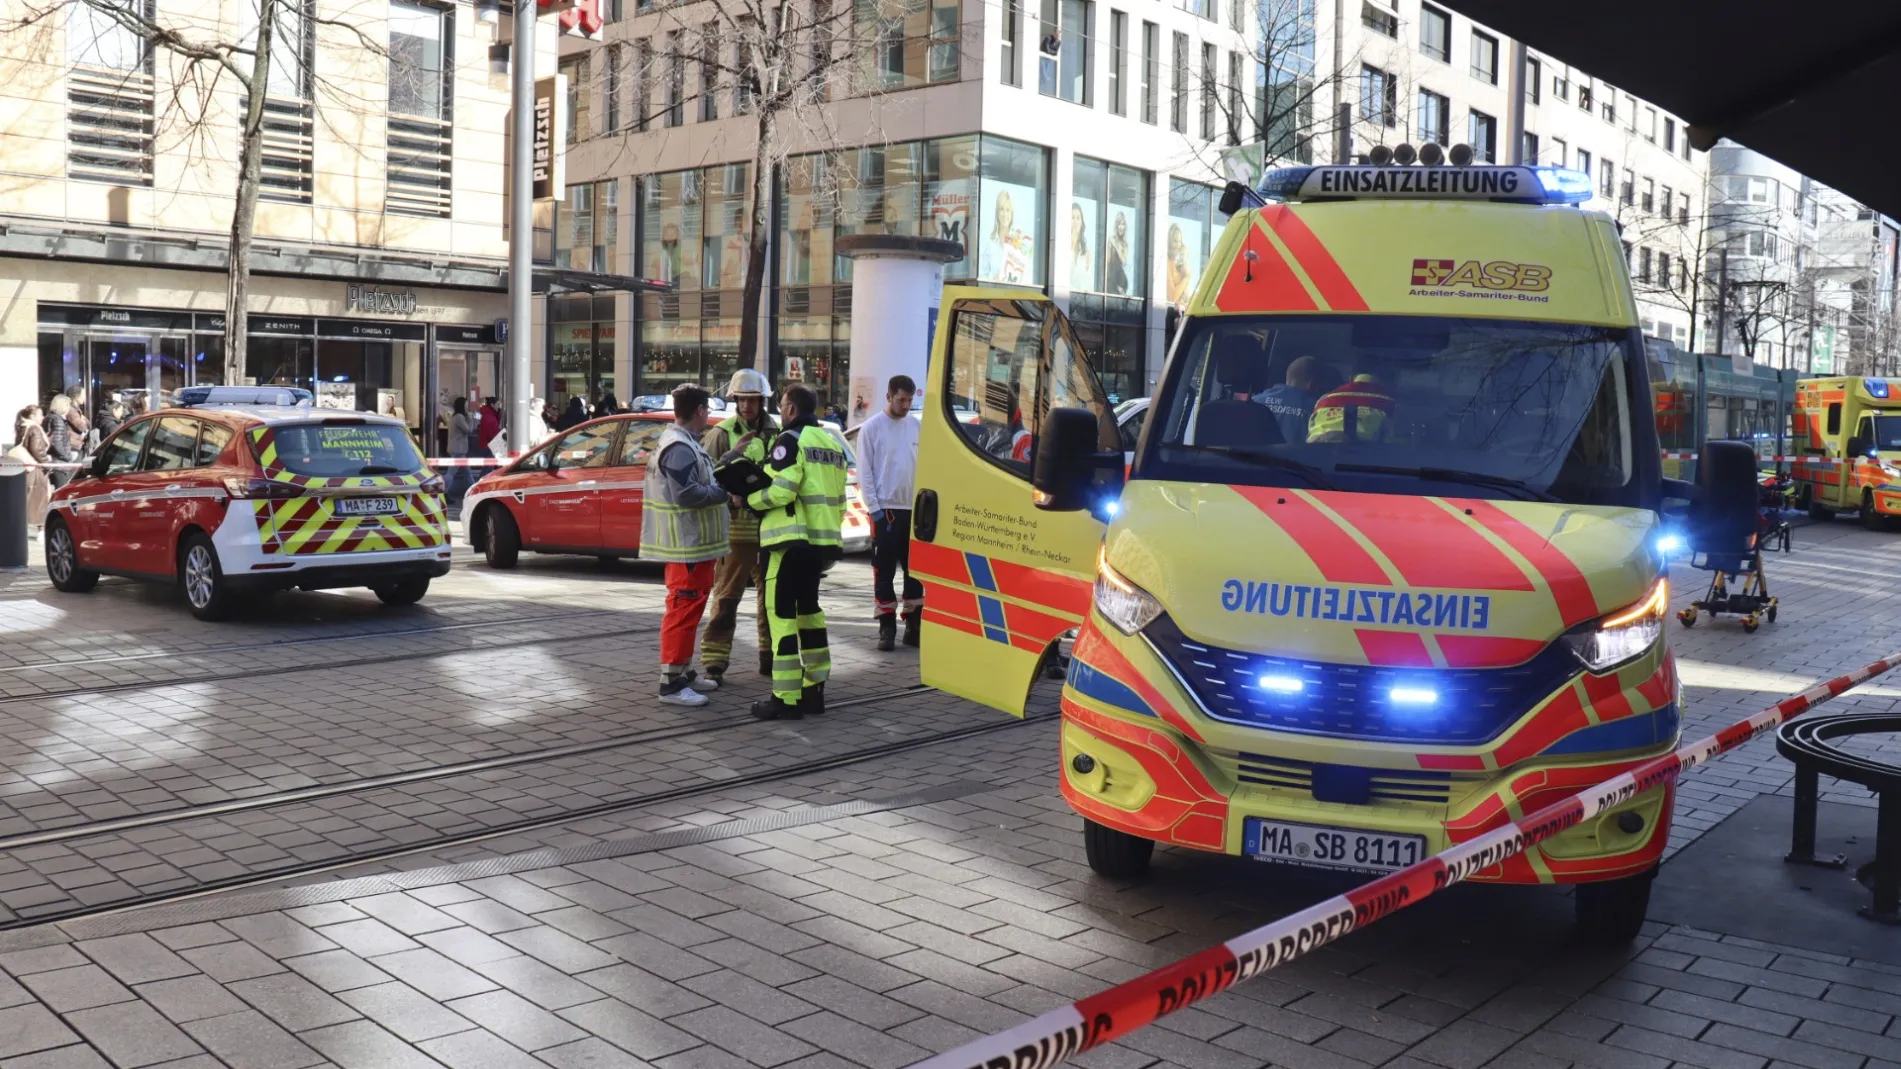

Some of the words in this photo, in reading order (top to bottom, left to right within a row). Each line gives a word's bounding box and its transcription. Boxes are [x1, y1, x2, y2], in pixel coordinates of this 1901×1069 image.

[534, 97, 550, 181] Pietzsch
[1321, 170, 1518, 193] EINSATZLEITUNG
[931, 194, 970, 205] Müller
[1443, 260, 1553, 292] ASB
[346, 284, 417, 314] Pietzsch
[1409, 288, 1549, 303] Arbeiter-Samariter-Bund
[101, 311, 130, 321] Pietzsch
[265, 322, 300, 330] ZENITH
[1265, 397, 1283, 405] ELW
[319, 430, 379, 438] FEUERWEHR
[322, 440, 384, 449] MANNHEIM
[354, 450, 373, 458] 112
[346, 501, 360, 511] MA
[366, 501, 374, 511] F
[376, 500, 393, 510] 239
[954, 503, 1038, 529] Arbeiter-Samariter-Bund
[953, 516, 1022, 540] Baden-Württemberg
[952, 528, 975, 542] Region
[976, 534, 1014, 551] Mannheim
[1021, 544, 1071, 563] Rhein-Neckar
[1261, 826, 1293, 857] MA
[1313, 832, 1346, 861] SB
[1353, 836, 1418, 868] 8111
